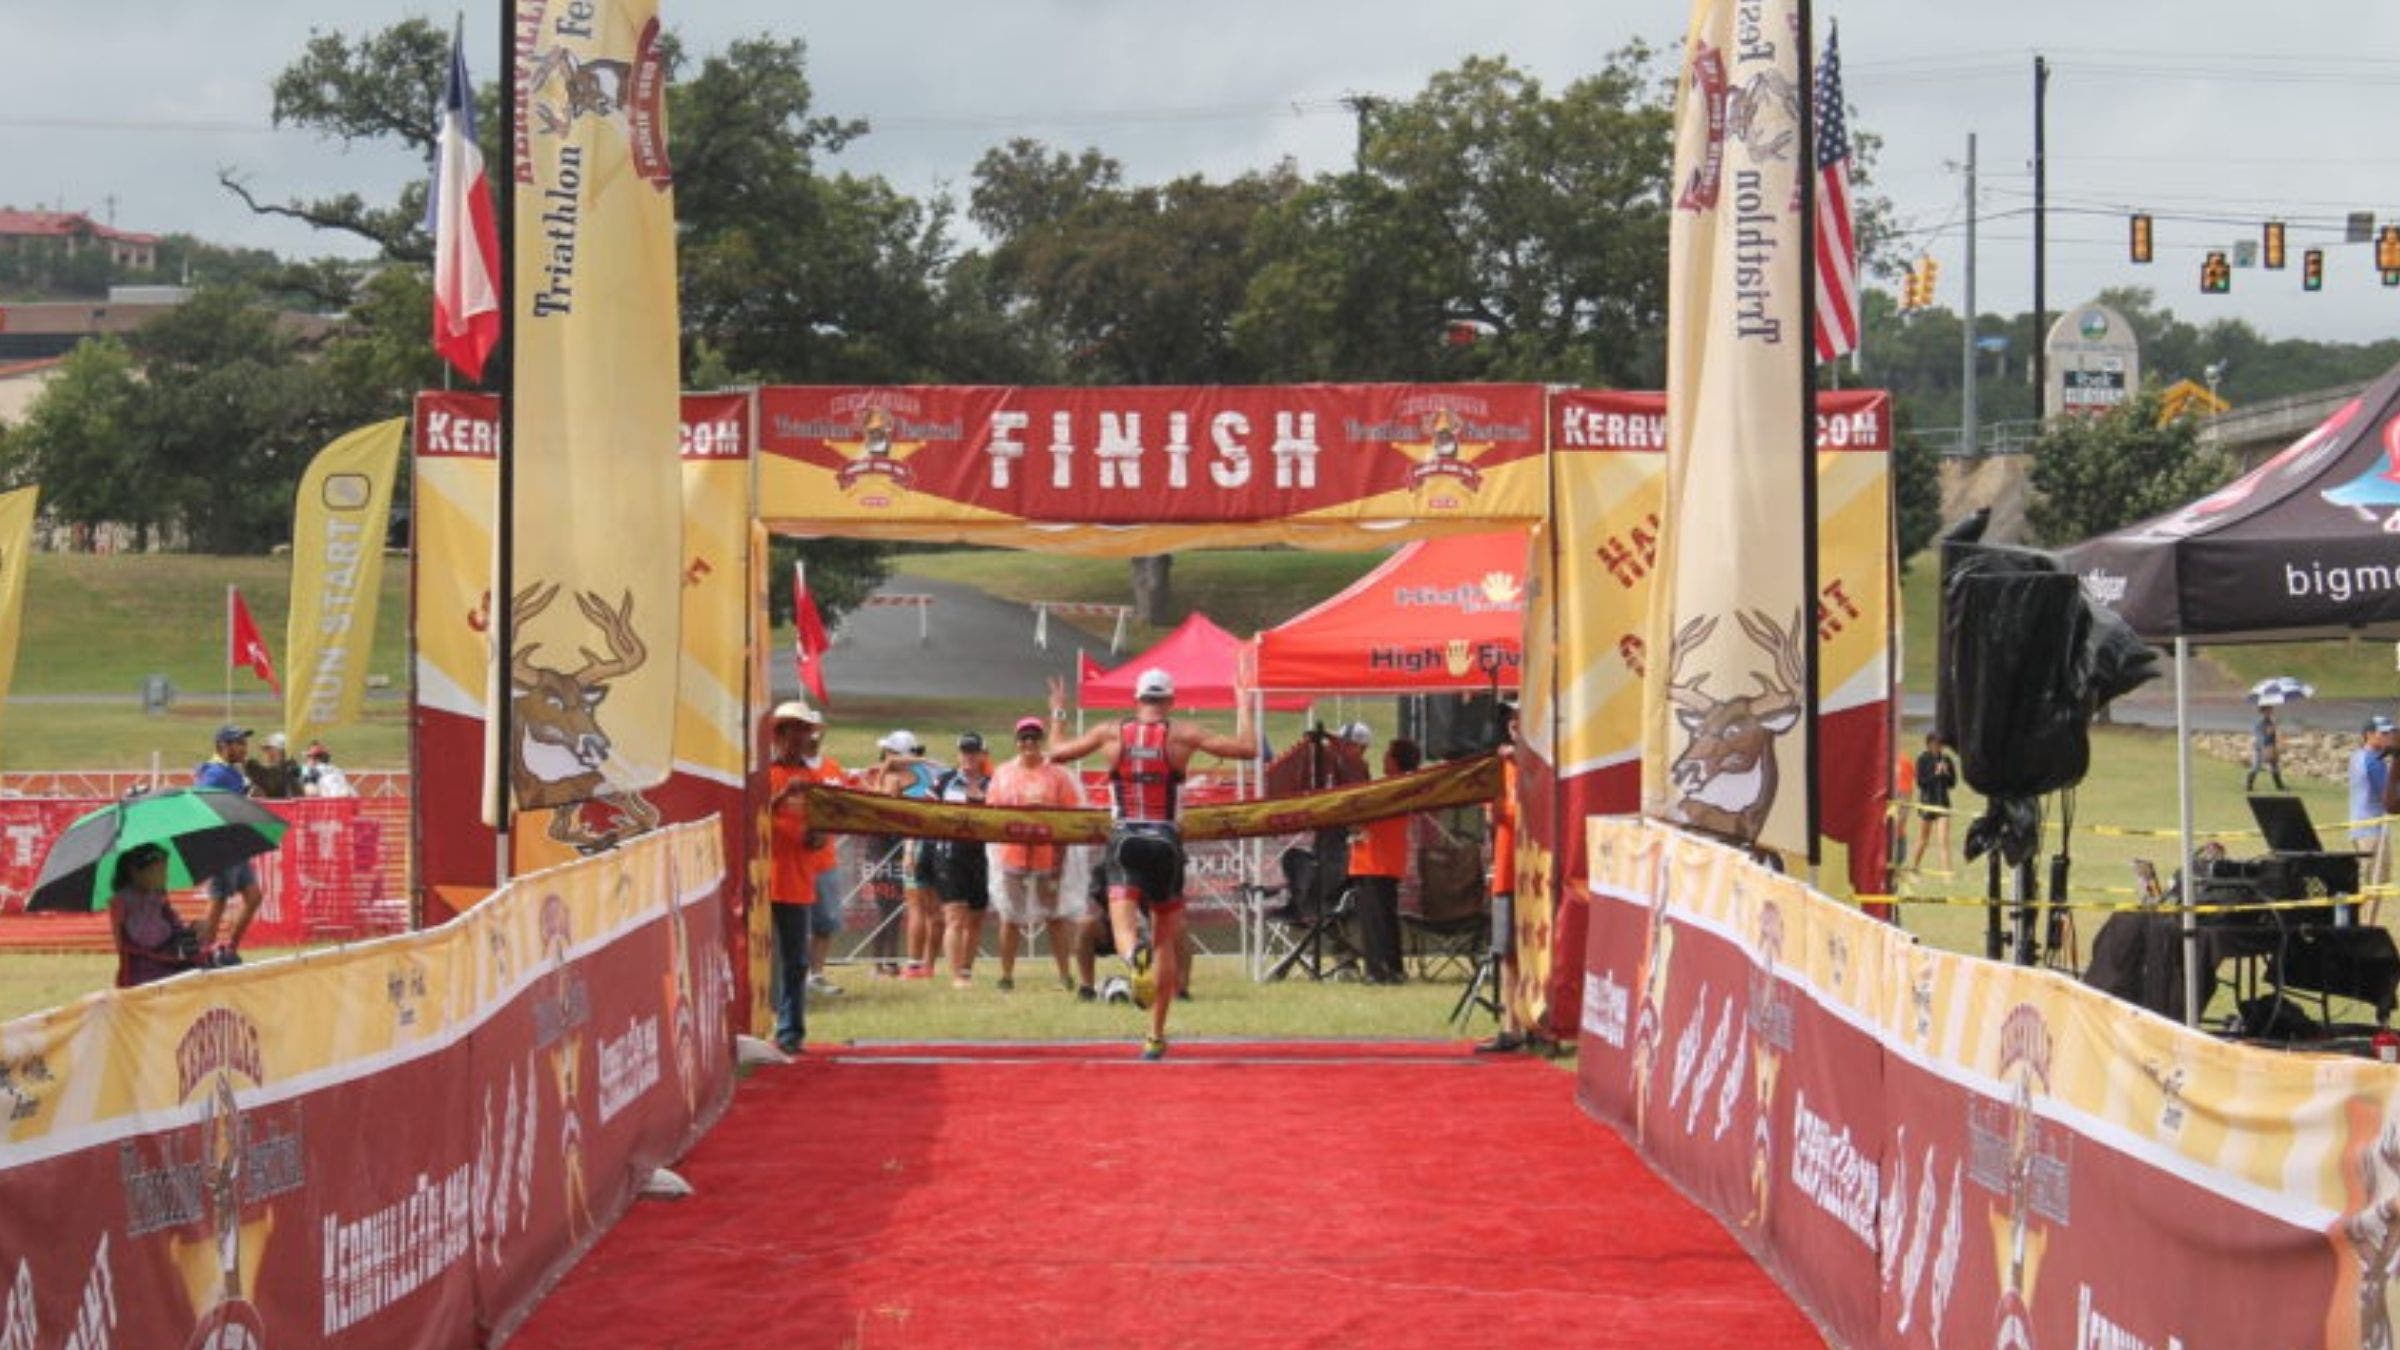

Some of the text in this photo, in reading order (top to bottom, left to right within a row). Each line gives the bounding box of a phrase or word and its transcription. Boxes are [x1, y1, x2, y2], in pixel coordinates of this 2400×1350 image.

[532, 0, 594, 318] Triathlon Fe
[428, 410, 500, 454] KER
[986, 409, 1321, 489] FINISH
[1562, 405, 1667, 448] KERRV
[308, 518, 365, 726] RUN START
[1370, 644, 1523, 674] High Fiv
